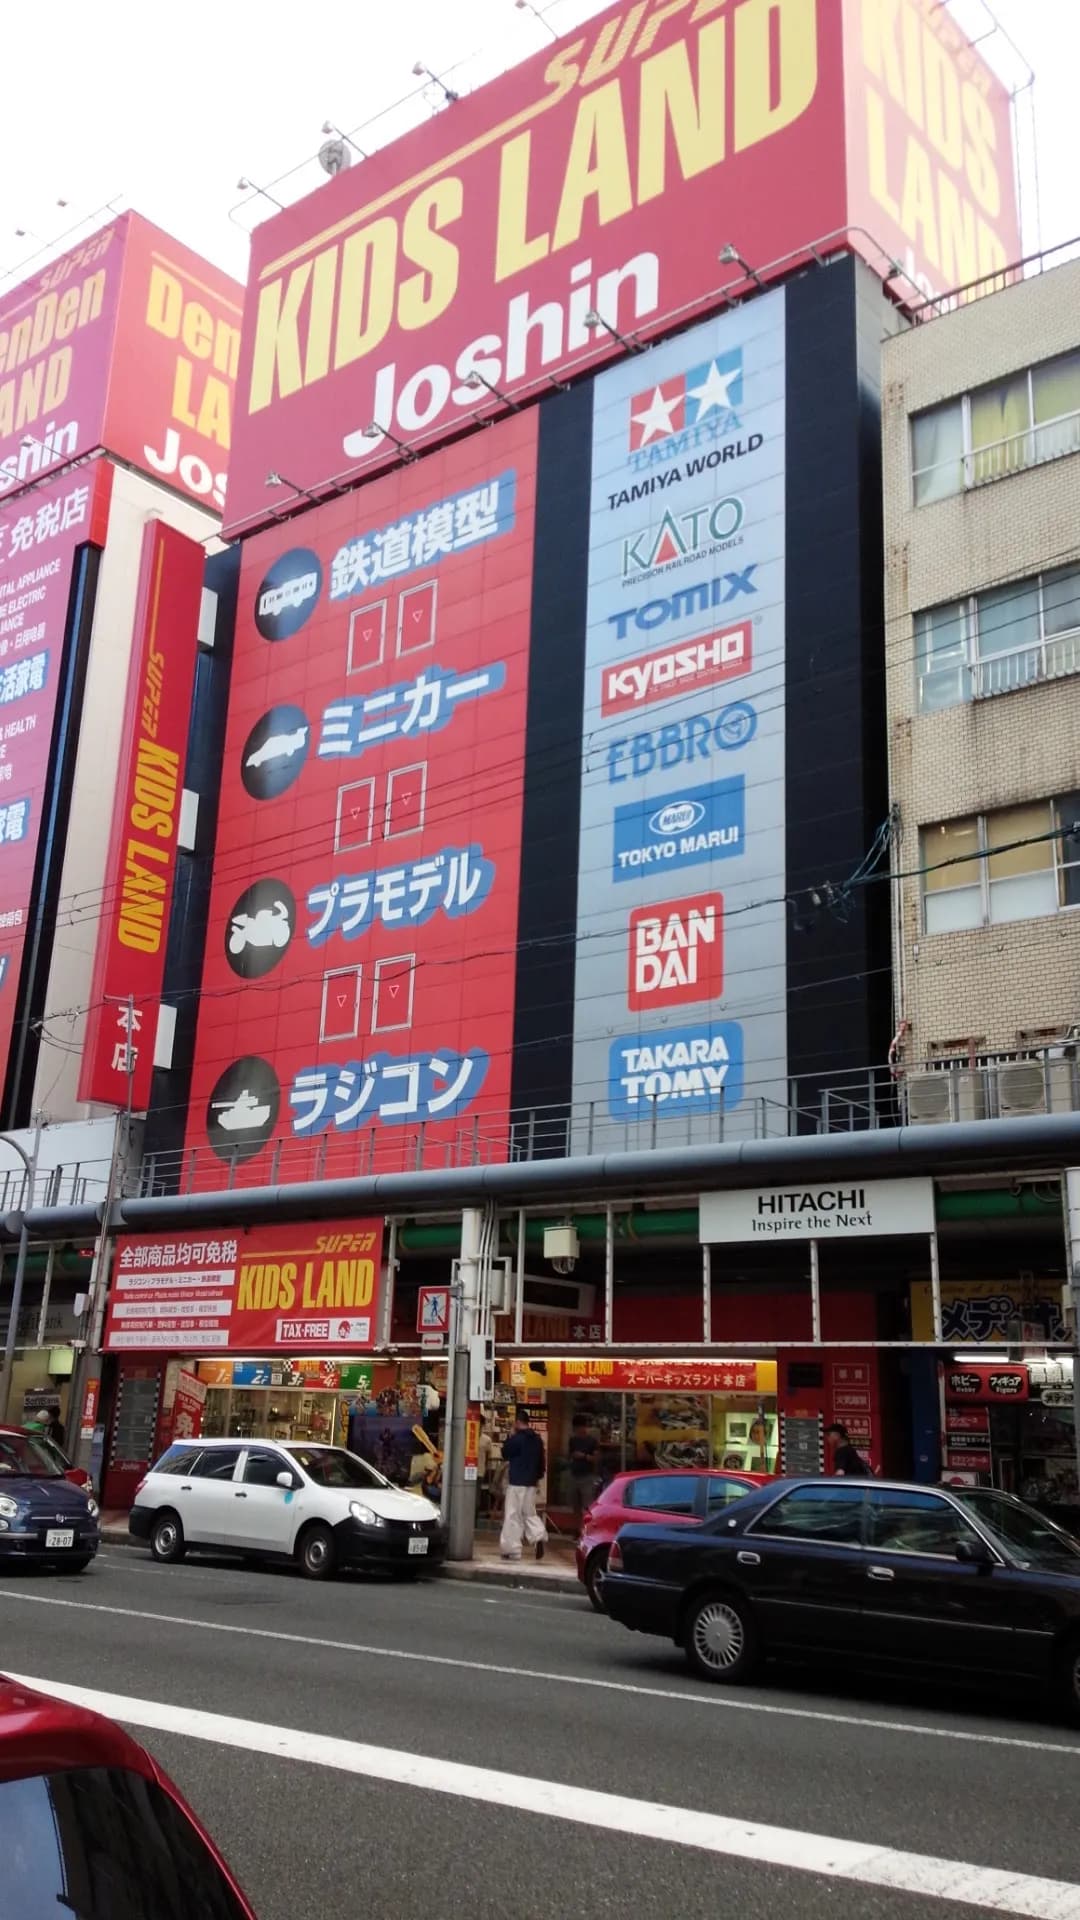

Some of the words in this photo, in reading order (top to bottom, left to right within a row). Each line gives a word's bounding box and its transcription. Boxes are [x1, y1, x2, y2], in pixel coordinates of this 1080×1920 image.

[248, 177, 463, 416] KIDS
[494, 0, 818, 283] LAND
[343, 251, 659, 458] Joshin
[627, 411, 744, 474] TAMIYA
[607, 467, 683, 511] TAMIYA
[685, 433, 764, 478] WORLD
[329, 480, 500, 600] 鉄道模型
[621, 566, 664, 588] PRECISION
[664, 549, 707, 572] RAILROAD
[708, 535, 745, 555] MODELS
[622, 497, 744, 577] KATO
[8, 586, 46, 615] ELECTRIC
[16, 558, 61, 590] APPLIANCE
[607, 563, 758, 640] TOMIX
[608, 630, 745, 701] KYOSHO
[142, 652, 165, 738] SUPER
[318, 673, 489, 756] ミニカー
[606, 701, 758, 785] EBBRO
[129, 738, 180, 838] KIDS
[617, 840, 676, 869] TOKYO
[679, 825, 739, 853] MARUI
[117, 838, 170, 953] LAND
[307, 852, 482, 940] プラモデル
[635, 905, 716, 957] BAN
[634, 946, 698, 993] DAI
[621, 1036, 730, 1073] TAKARA
[289, 1058, 474, 1131] ラジコン
[621, 1064, 730, 1105] TOMY
[751, 1218, 802, 1234] Inspire
[807, 1214, 831, 1229] the
[836, 1211, 873, 1227] Next
[757, 1188, 866, 1215] HITACHI
[119, 1239, 238, 1268] 全部商品均可免税
[315, 1232, 377, 1254] SUPER
[236, 1262, 297, 1311] KIDS
[302, 1258, 375, 1309] LAND
[576, 1375, 600, 1385] Joshin
[951, 1374, 980, 1385] ホビー
[989, 1375, 1022, 1387] フィギュア
